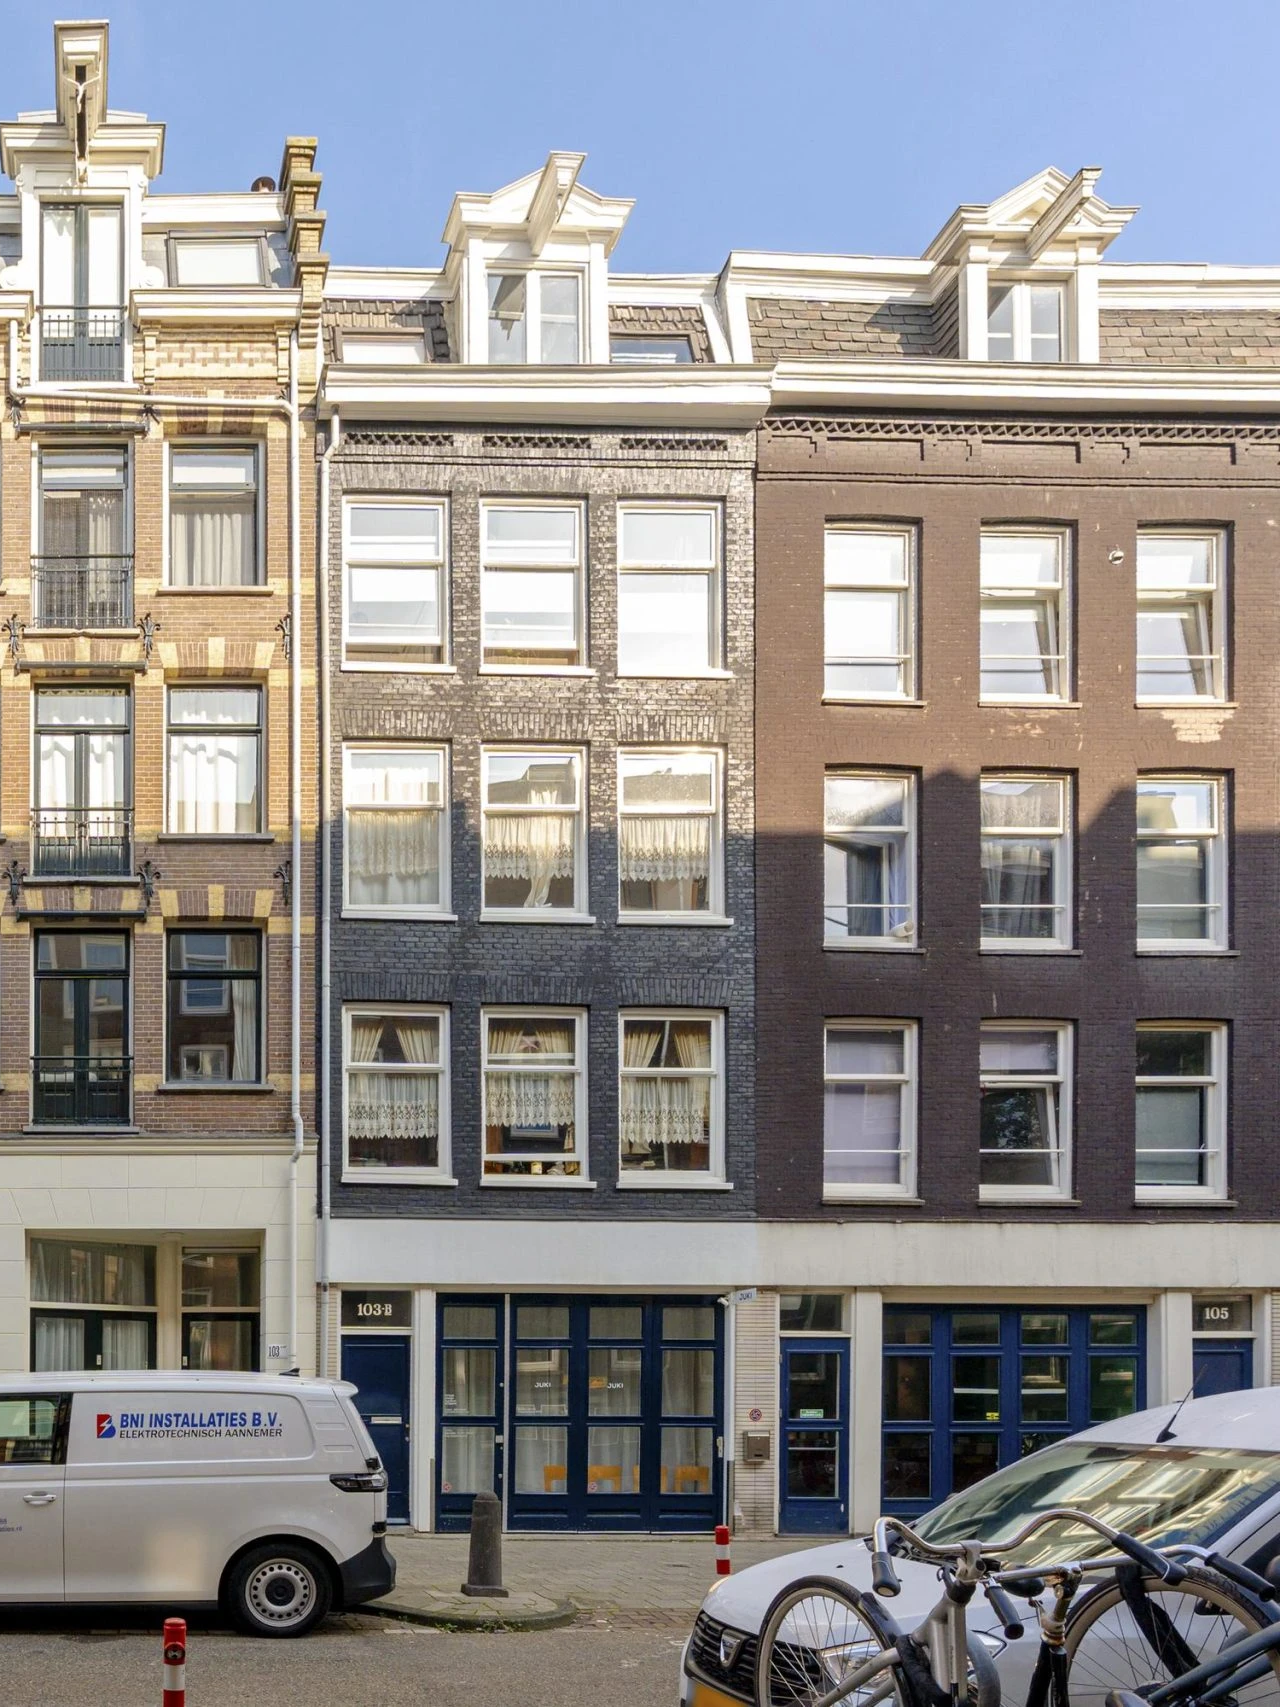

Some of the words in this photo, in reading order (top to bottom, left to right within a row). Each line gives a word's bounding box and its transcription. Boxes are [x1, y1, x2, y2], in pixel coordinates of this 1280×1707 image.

[739, 1292, 753, 1301] JUKI
[1205, 1307, 1229, 1319] 105
[268, 1345, 280, 1357] 103
[120, 1413, 145, 1429] BNI
[149, 1411, 247, 1428] INSTALLATIES
[251, 1411, 283, 1427] B.V.
[120, 1429, 221, 1439] ELEKTROTECHNISCH
[225, 1428, 283, 1438] AANNEMER
